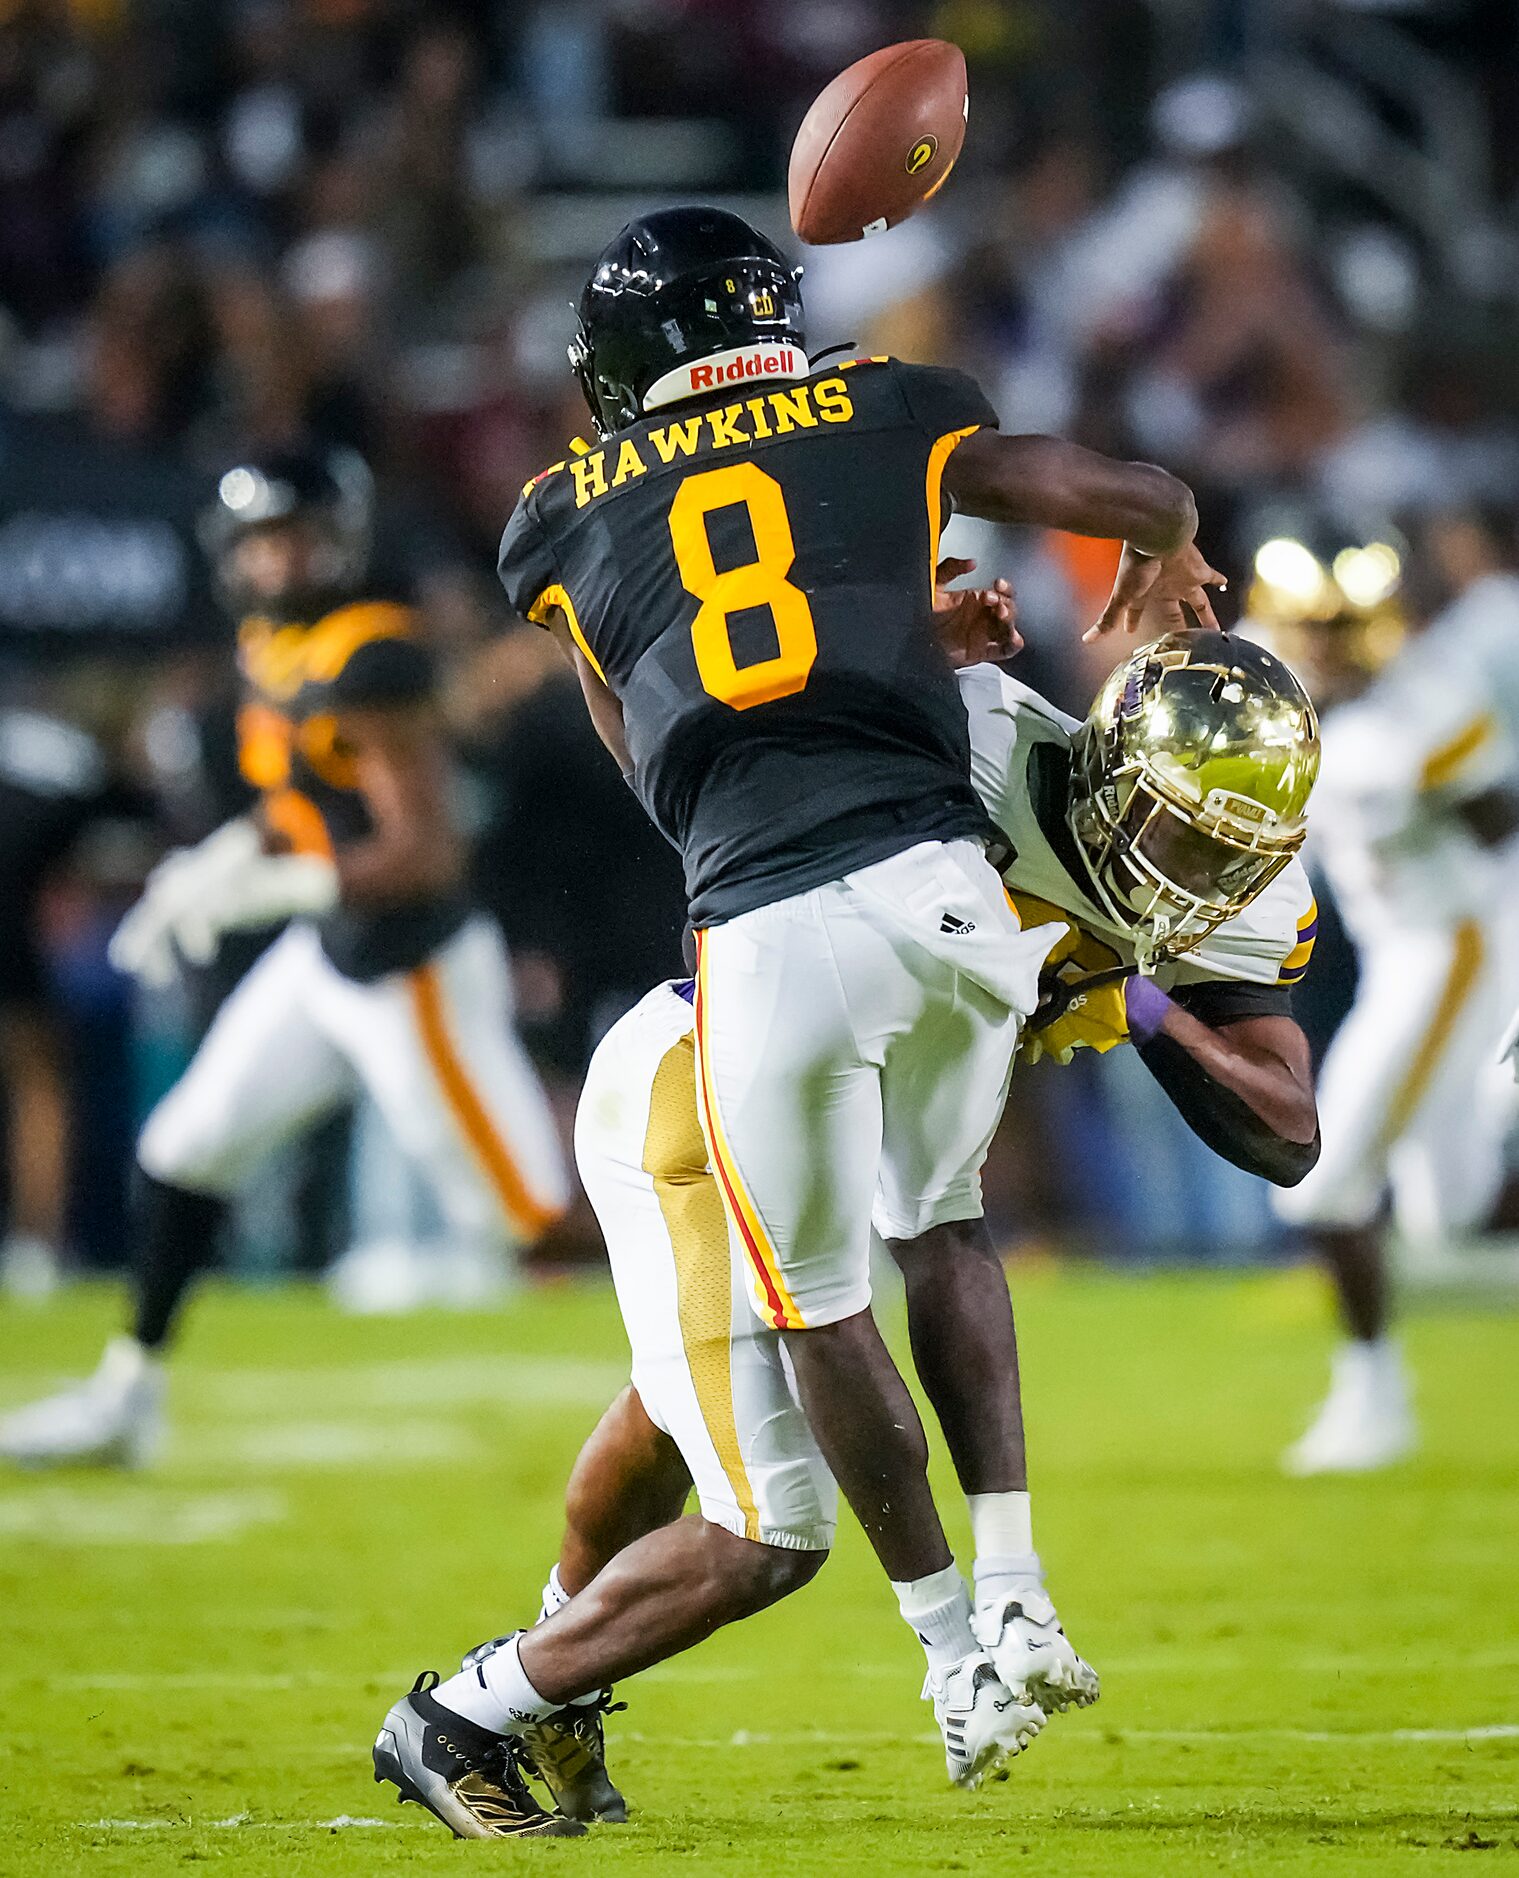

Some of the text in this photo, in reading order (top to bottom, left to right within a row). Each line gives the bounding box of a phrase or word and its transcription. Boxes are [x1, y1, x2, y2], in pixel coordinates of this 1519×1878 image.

[725, 278, 736, 294] 8
[690, 350, 794, 391] Riddell
[569, 378, 854, 510] HAWKINS
[668, 461, 818, 712] 8
